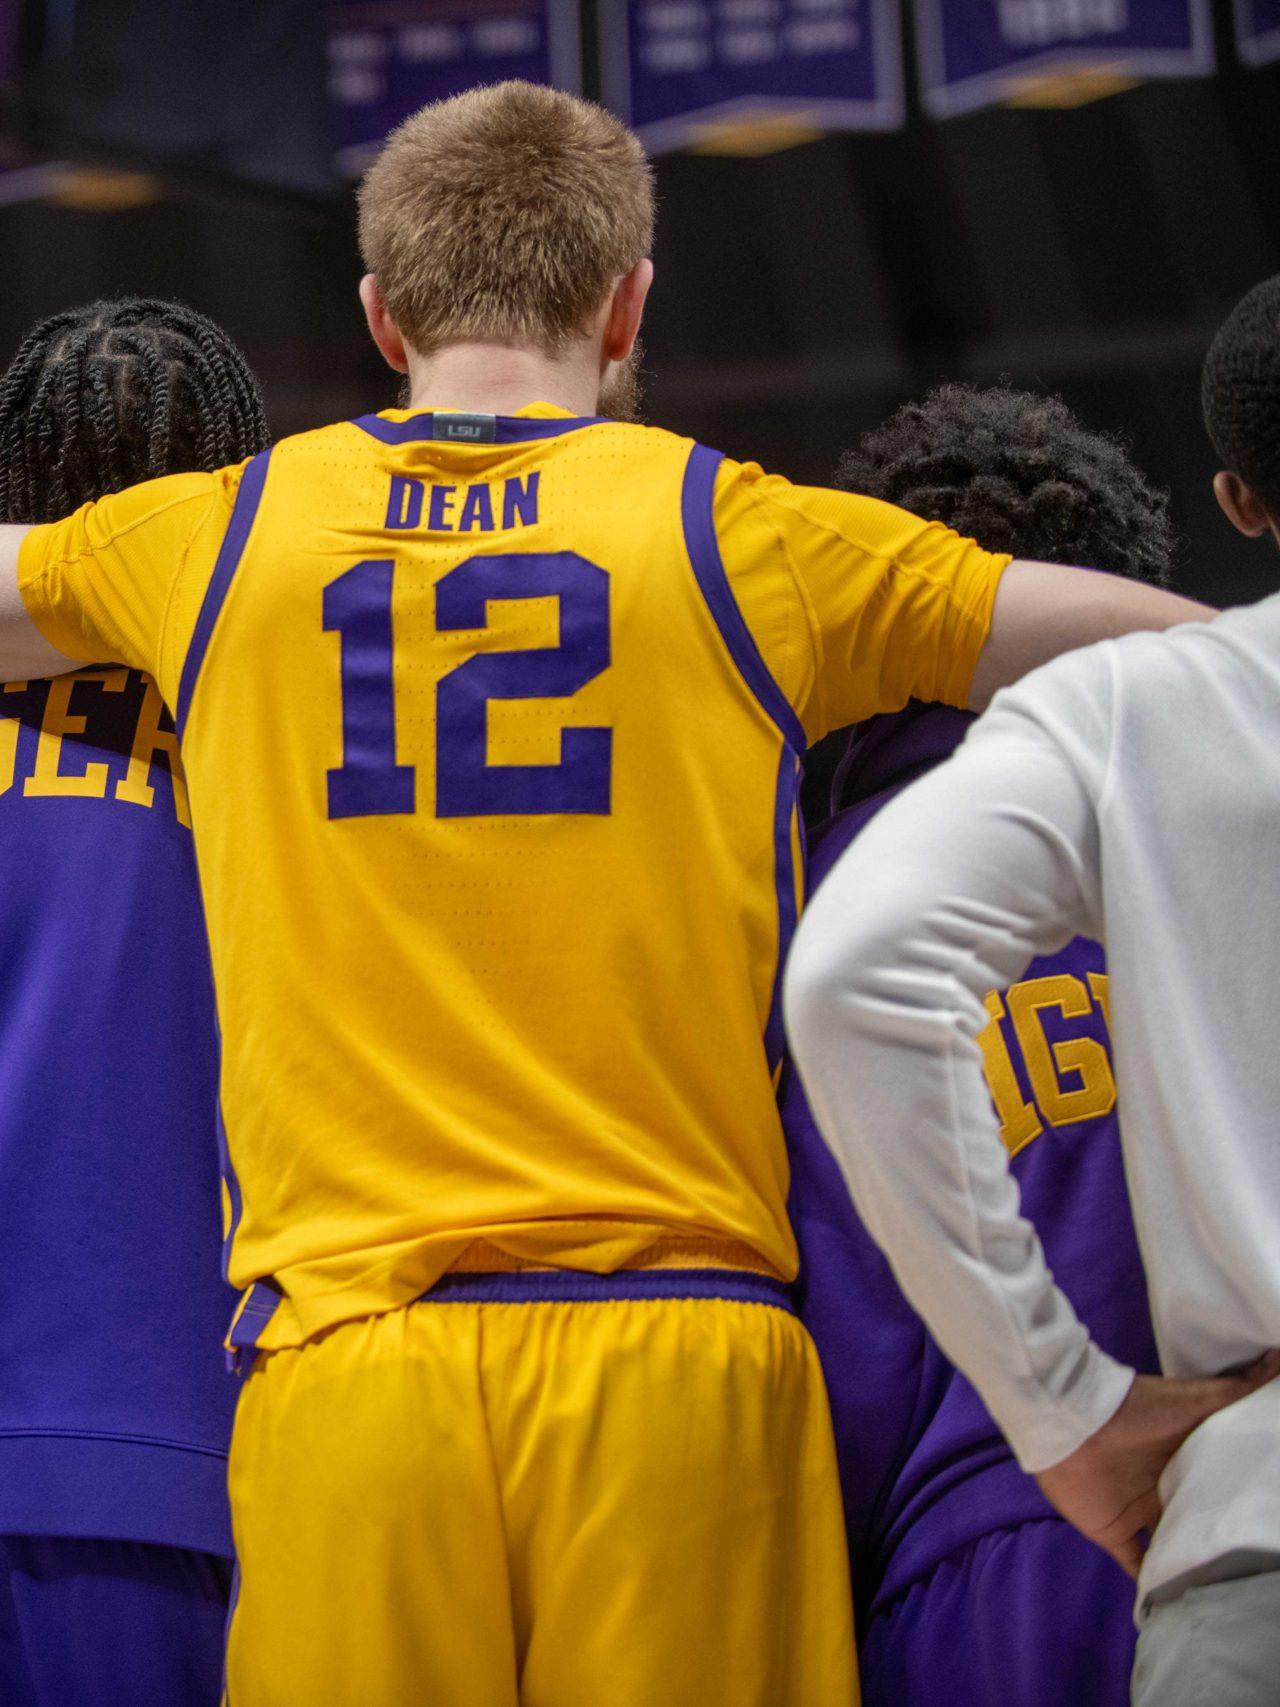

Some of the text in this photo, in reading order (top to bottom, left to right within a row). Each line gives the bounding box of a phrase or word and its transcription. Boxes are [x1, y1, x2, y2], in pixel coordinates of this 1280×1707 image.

[447, 424, 481, 438] LSU
[384, 470, 541, 532] DEAN
[323, 549, 613, 820] 12
